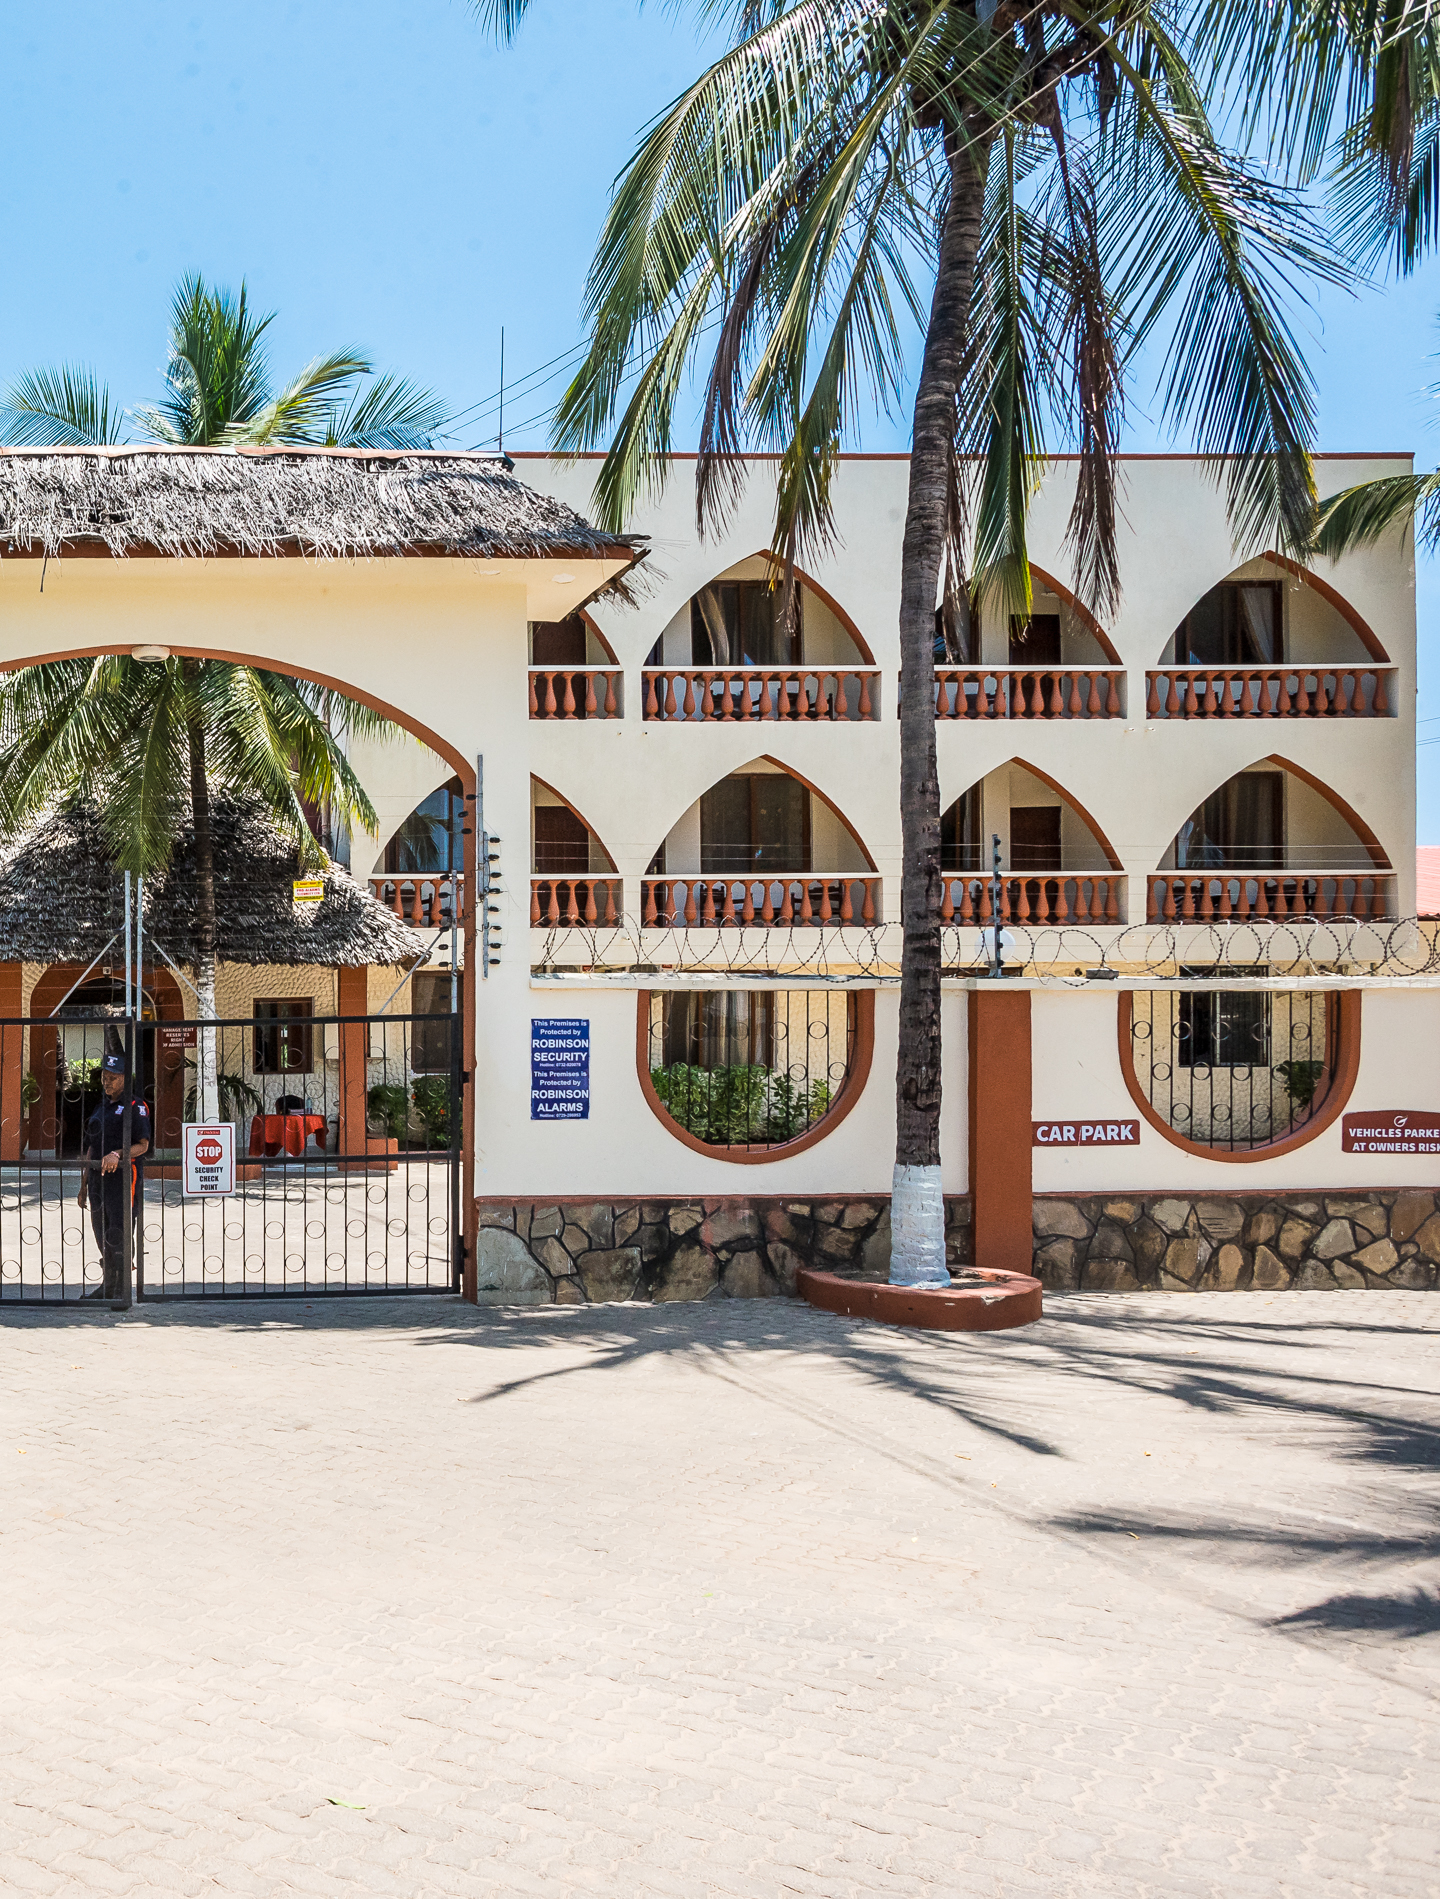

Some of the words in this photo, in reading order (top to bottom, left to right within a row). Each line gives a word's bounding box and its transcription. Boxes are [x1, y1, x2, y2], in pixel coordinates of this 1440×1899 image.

[532, 1039, 589, 1048] ROBINSON
[533, 1052, 588, 1061] SECURITY
[531, 1090, 589, 1099] ROBINSON
[537, 1103, 584, 1112] ALARMS
[1036, 1125, 1076, 1142] CAR
[1081, 1124, 1134, 1141] PARK
[1348, 1128, 1402, 1137] VEHICLES
[1404, 1128, 1440, 1138] PARKE
[196, 1146, 221, 1157] STOP
[1352, 1142, 1366, 1151] AT
[1368, 1142, 1416, 1152] OWNERS
